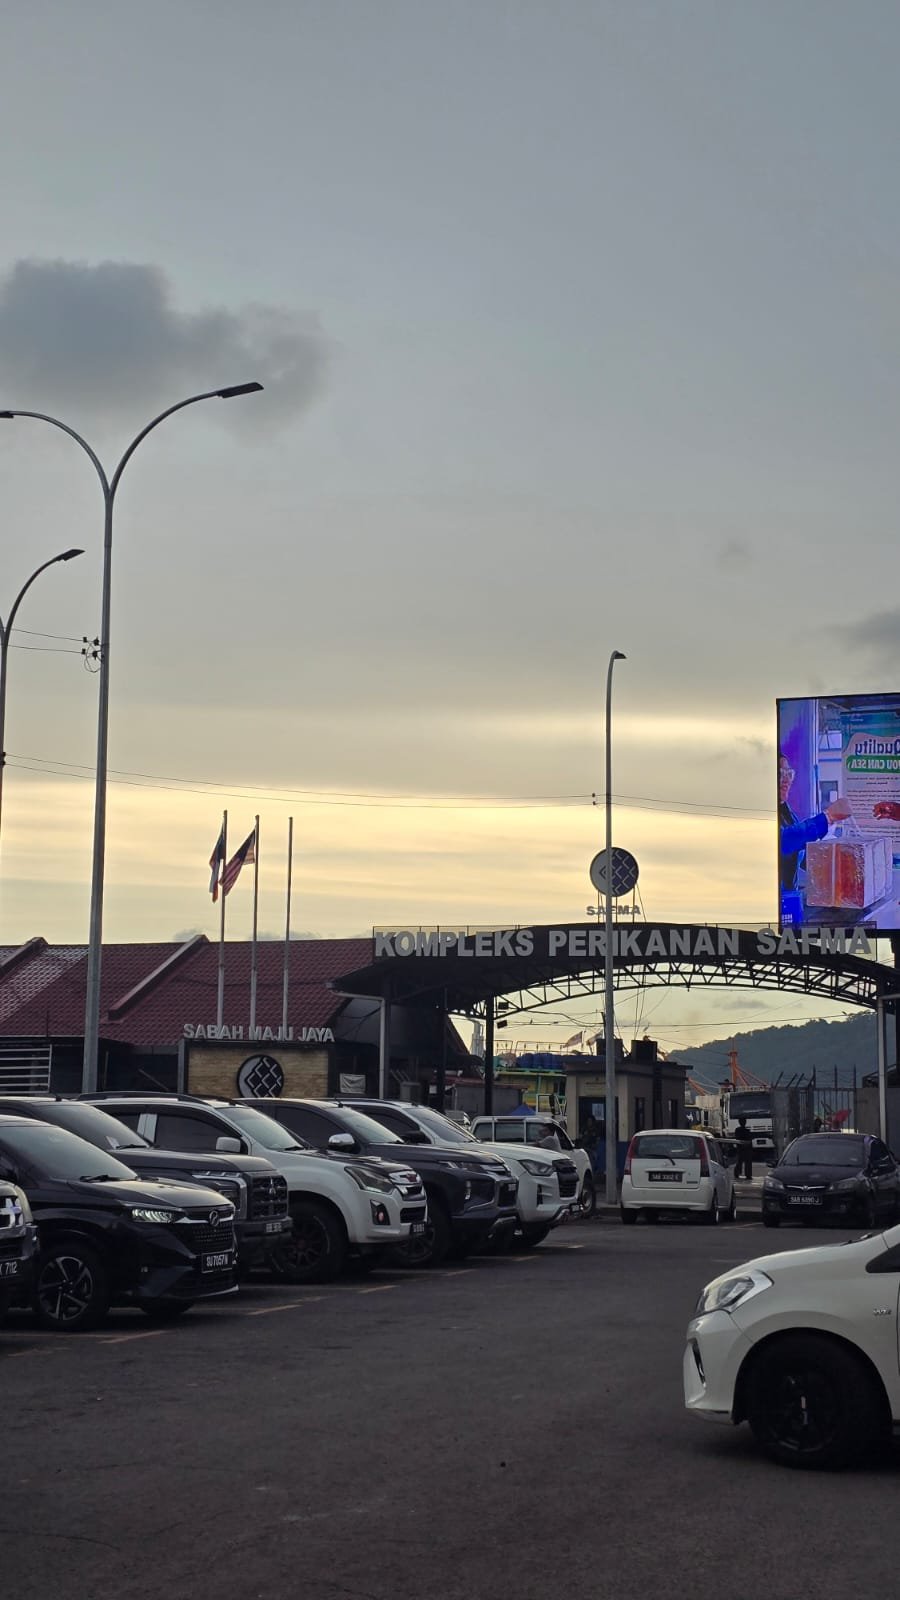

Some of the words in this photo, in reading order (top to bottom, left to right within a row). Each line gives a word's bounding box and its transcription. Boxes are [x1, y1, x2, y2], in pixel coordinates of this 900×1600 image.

[375, 929, 534, 957] KOMPLEKS
[548, 929, 739, 957] PERIKANAN
[756, 926, 872, 955] SAFMA
[183, 1023, 244, 1040] SABAH
[298, 1026, 336, 1043] JAYA
